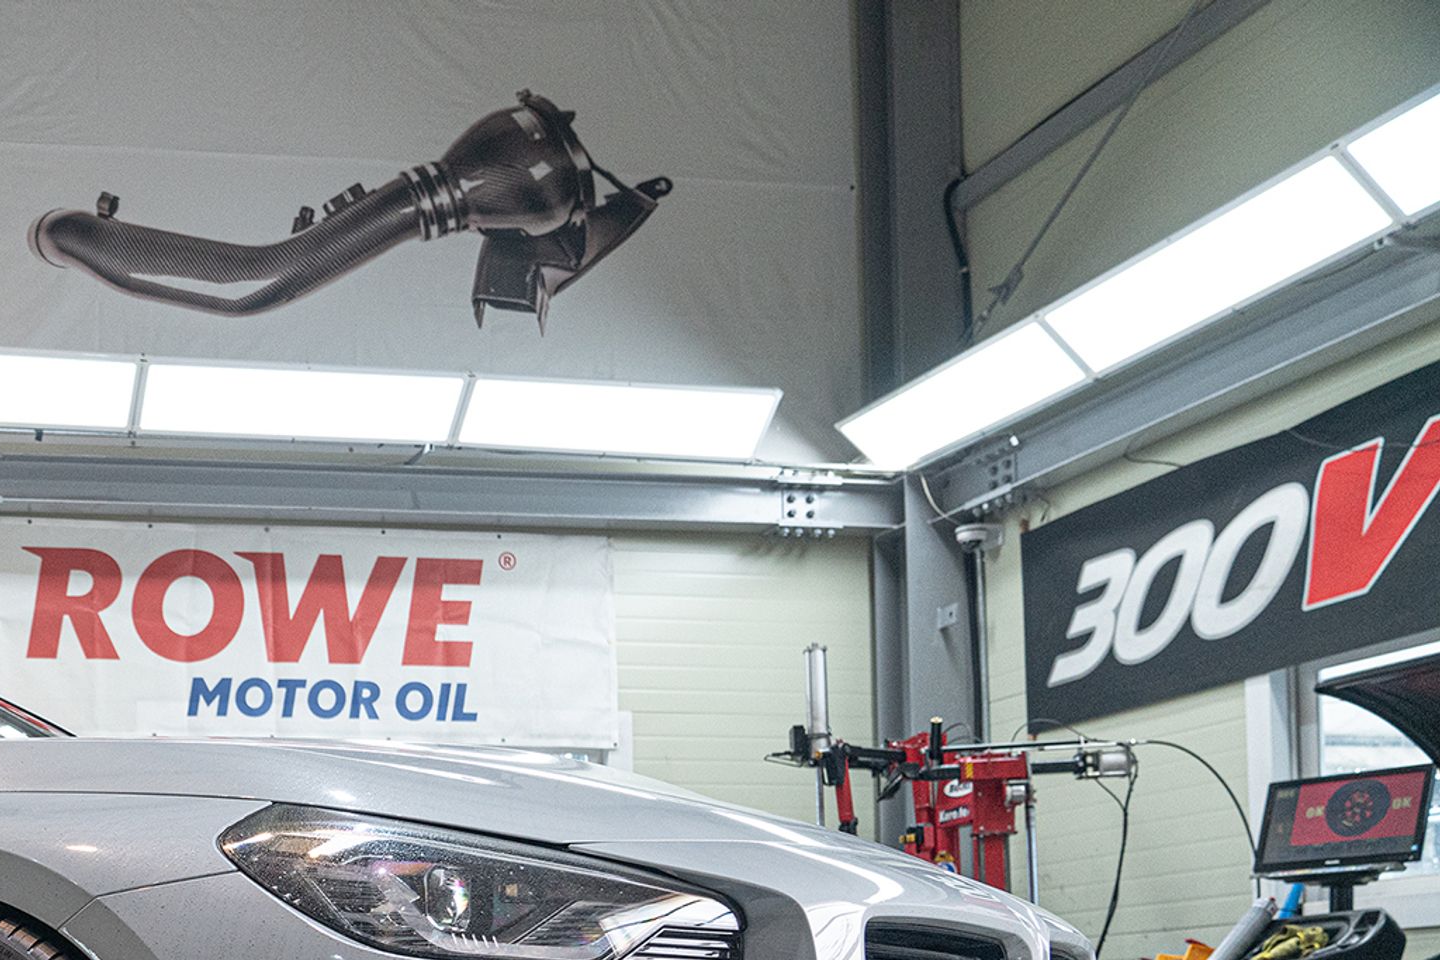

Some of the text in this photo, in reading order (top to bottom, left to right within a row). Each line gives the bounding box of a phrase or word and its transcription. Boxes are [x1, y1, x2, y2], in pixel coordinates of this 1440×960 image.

[20, 546, 483, 668] ROWE
[1046, 414, 1440, 688] 300V
[187, 676, 478, 723] MOTOR OIL
